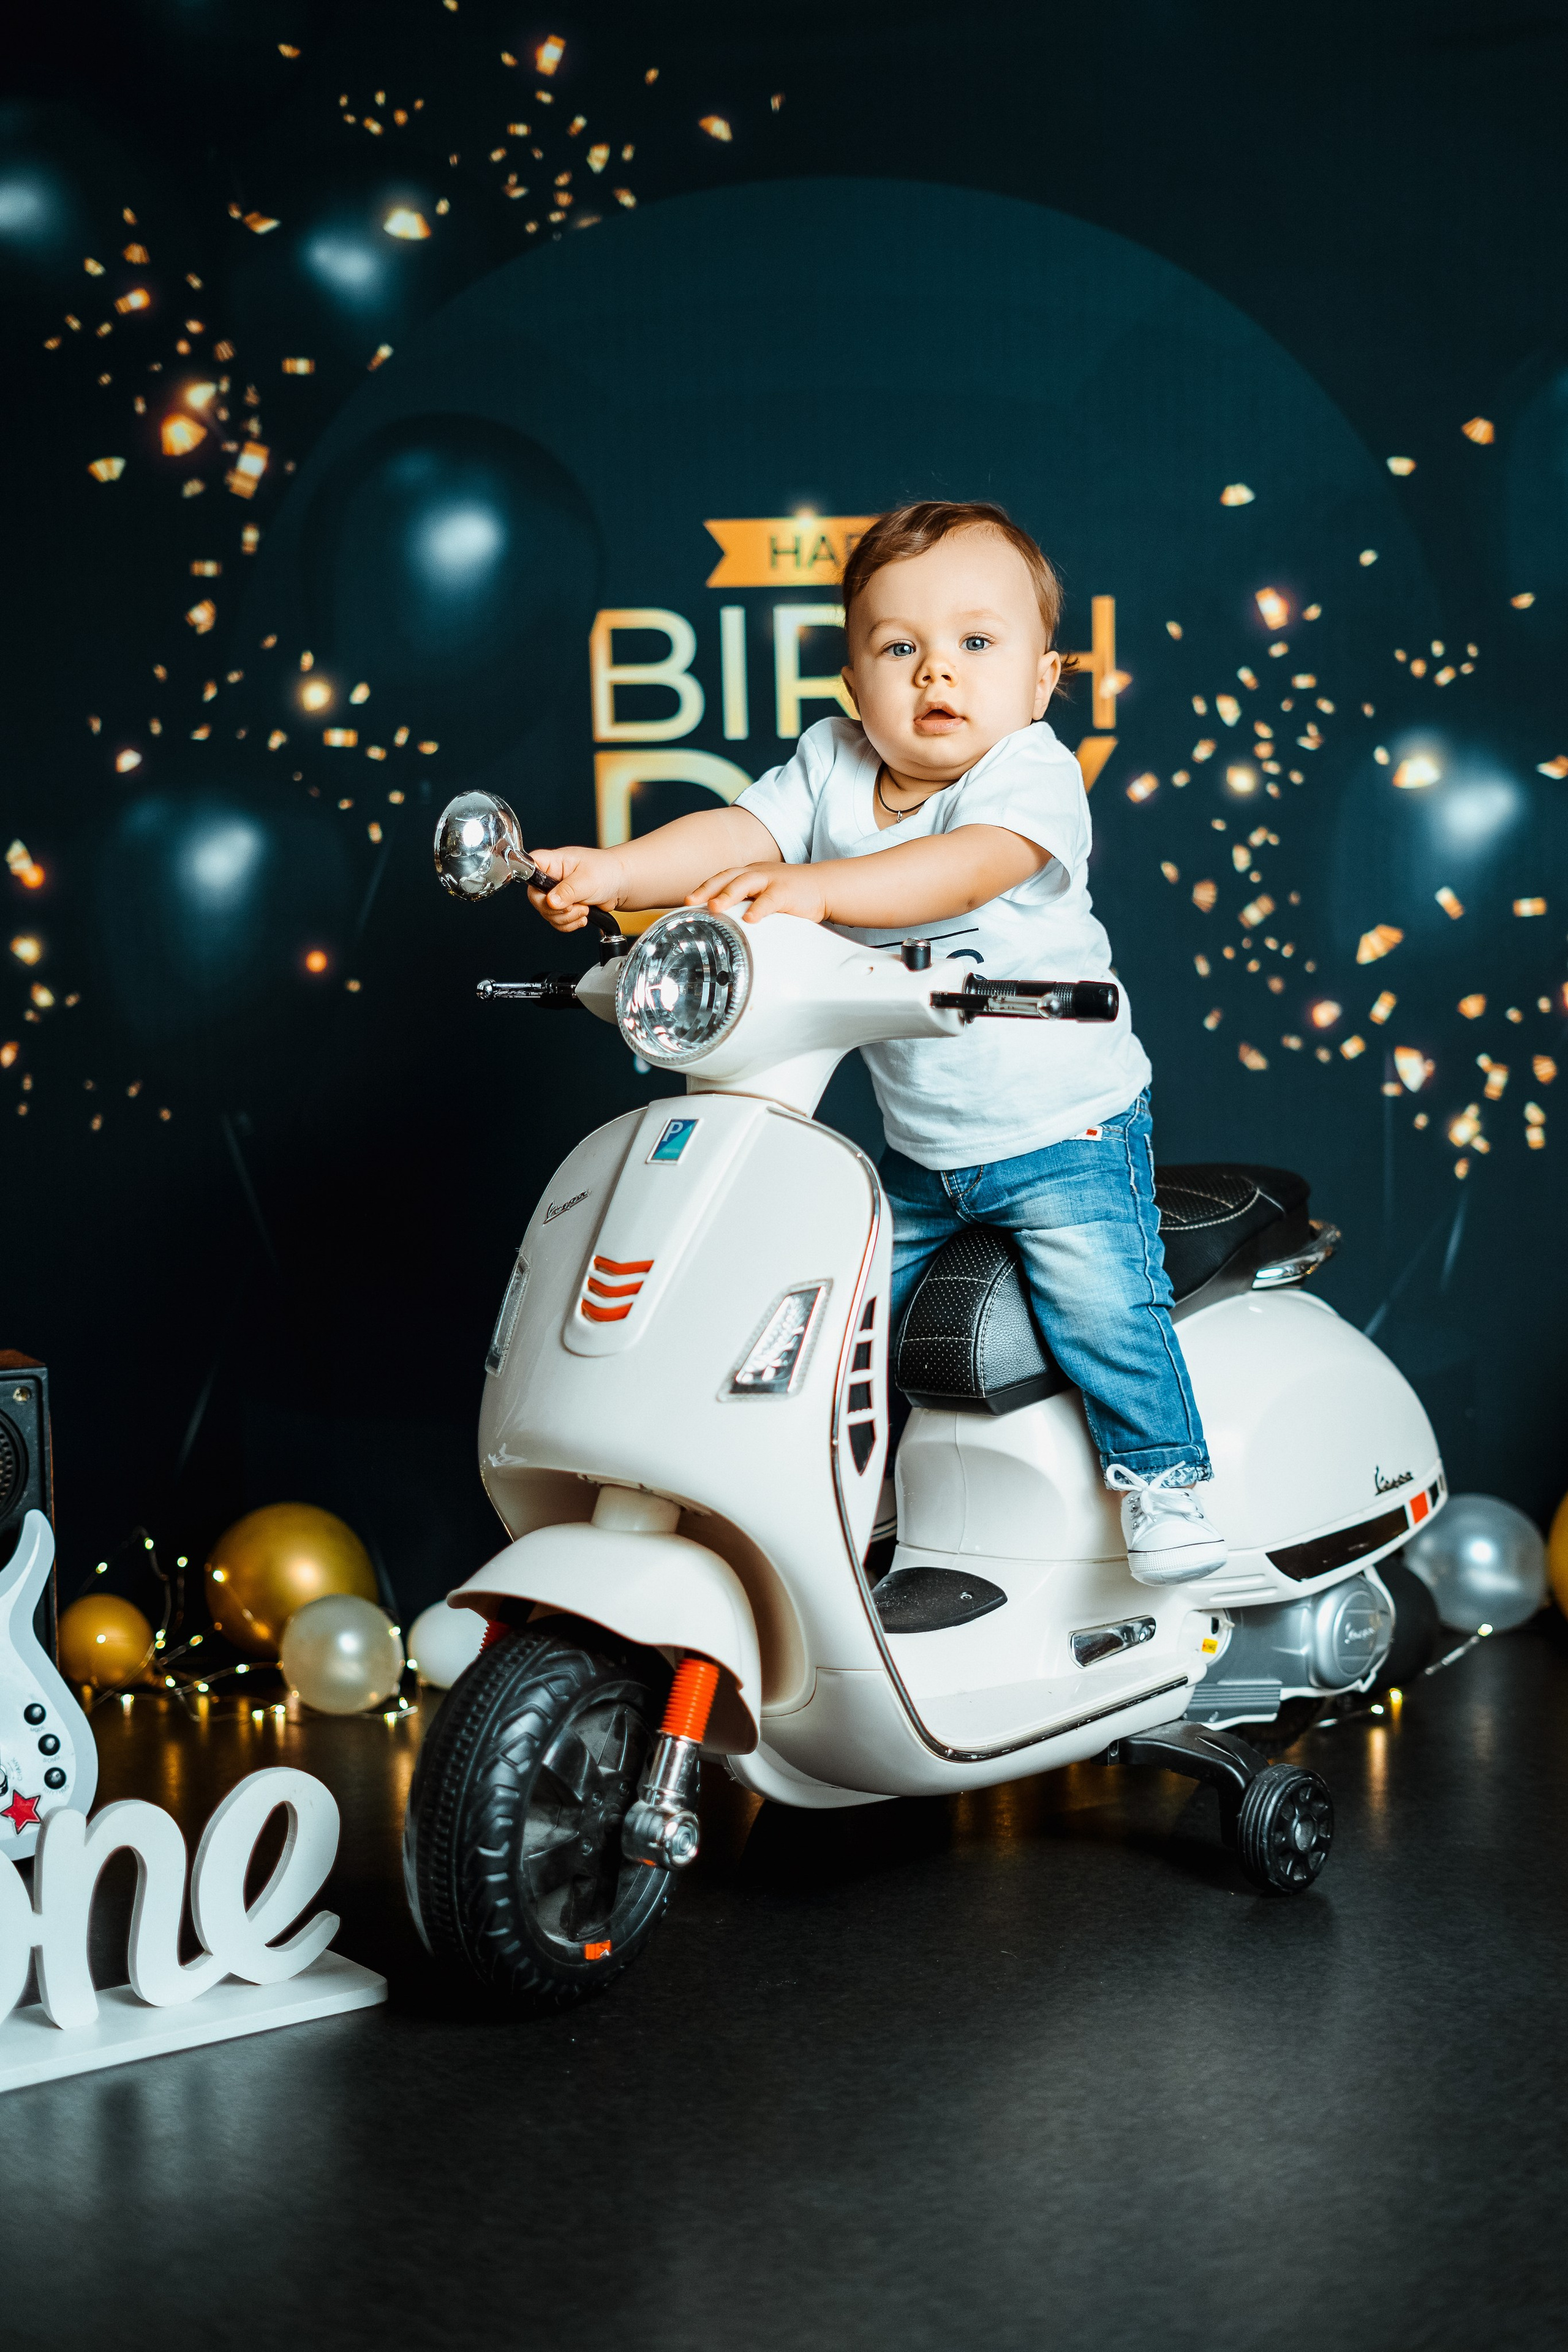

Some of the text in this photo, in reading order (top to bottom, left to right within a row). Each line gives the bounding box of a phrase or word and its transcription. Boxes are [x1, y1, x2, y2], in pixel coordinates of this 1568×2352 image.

[662, 1121, 684, 1142] P
[543, 1189, 591, 1226] Vespa
[1374, 1464, 1414, 1496] Vespa
